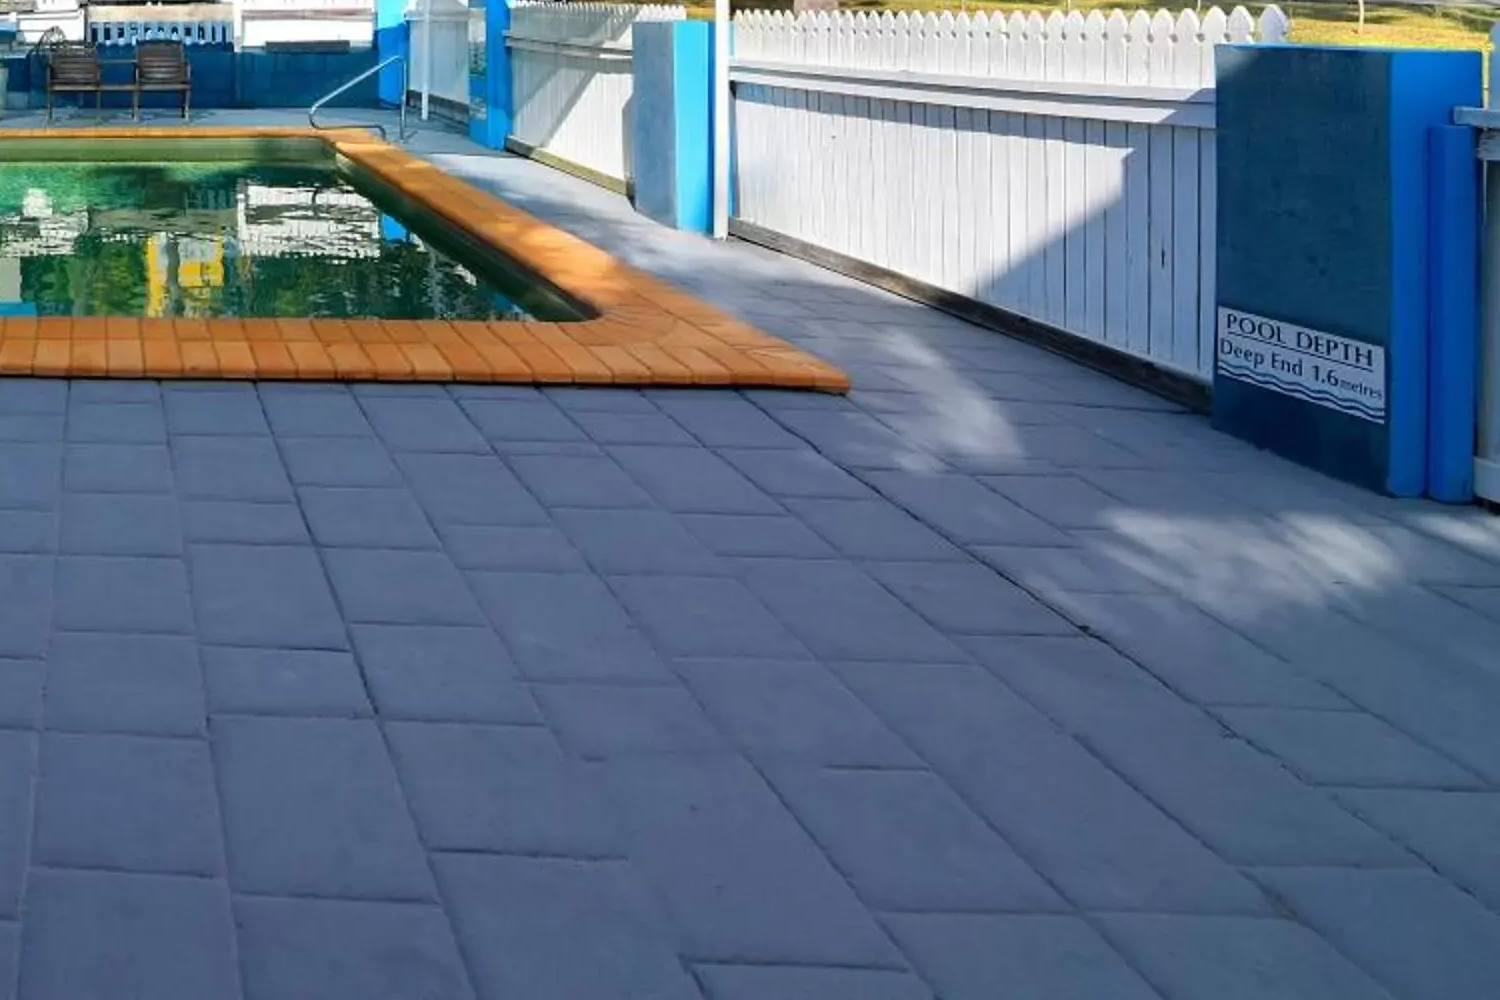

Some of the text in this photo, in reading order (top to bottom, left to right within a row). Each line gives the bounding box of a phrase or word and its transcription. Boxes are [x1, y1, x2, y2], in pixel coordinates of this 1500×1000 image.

[1219, 338, 1265, 369] Deep
[1271, 352, 1303, 377] End
[1227, 313, 1374, 367] POOL DEPTH
